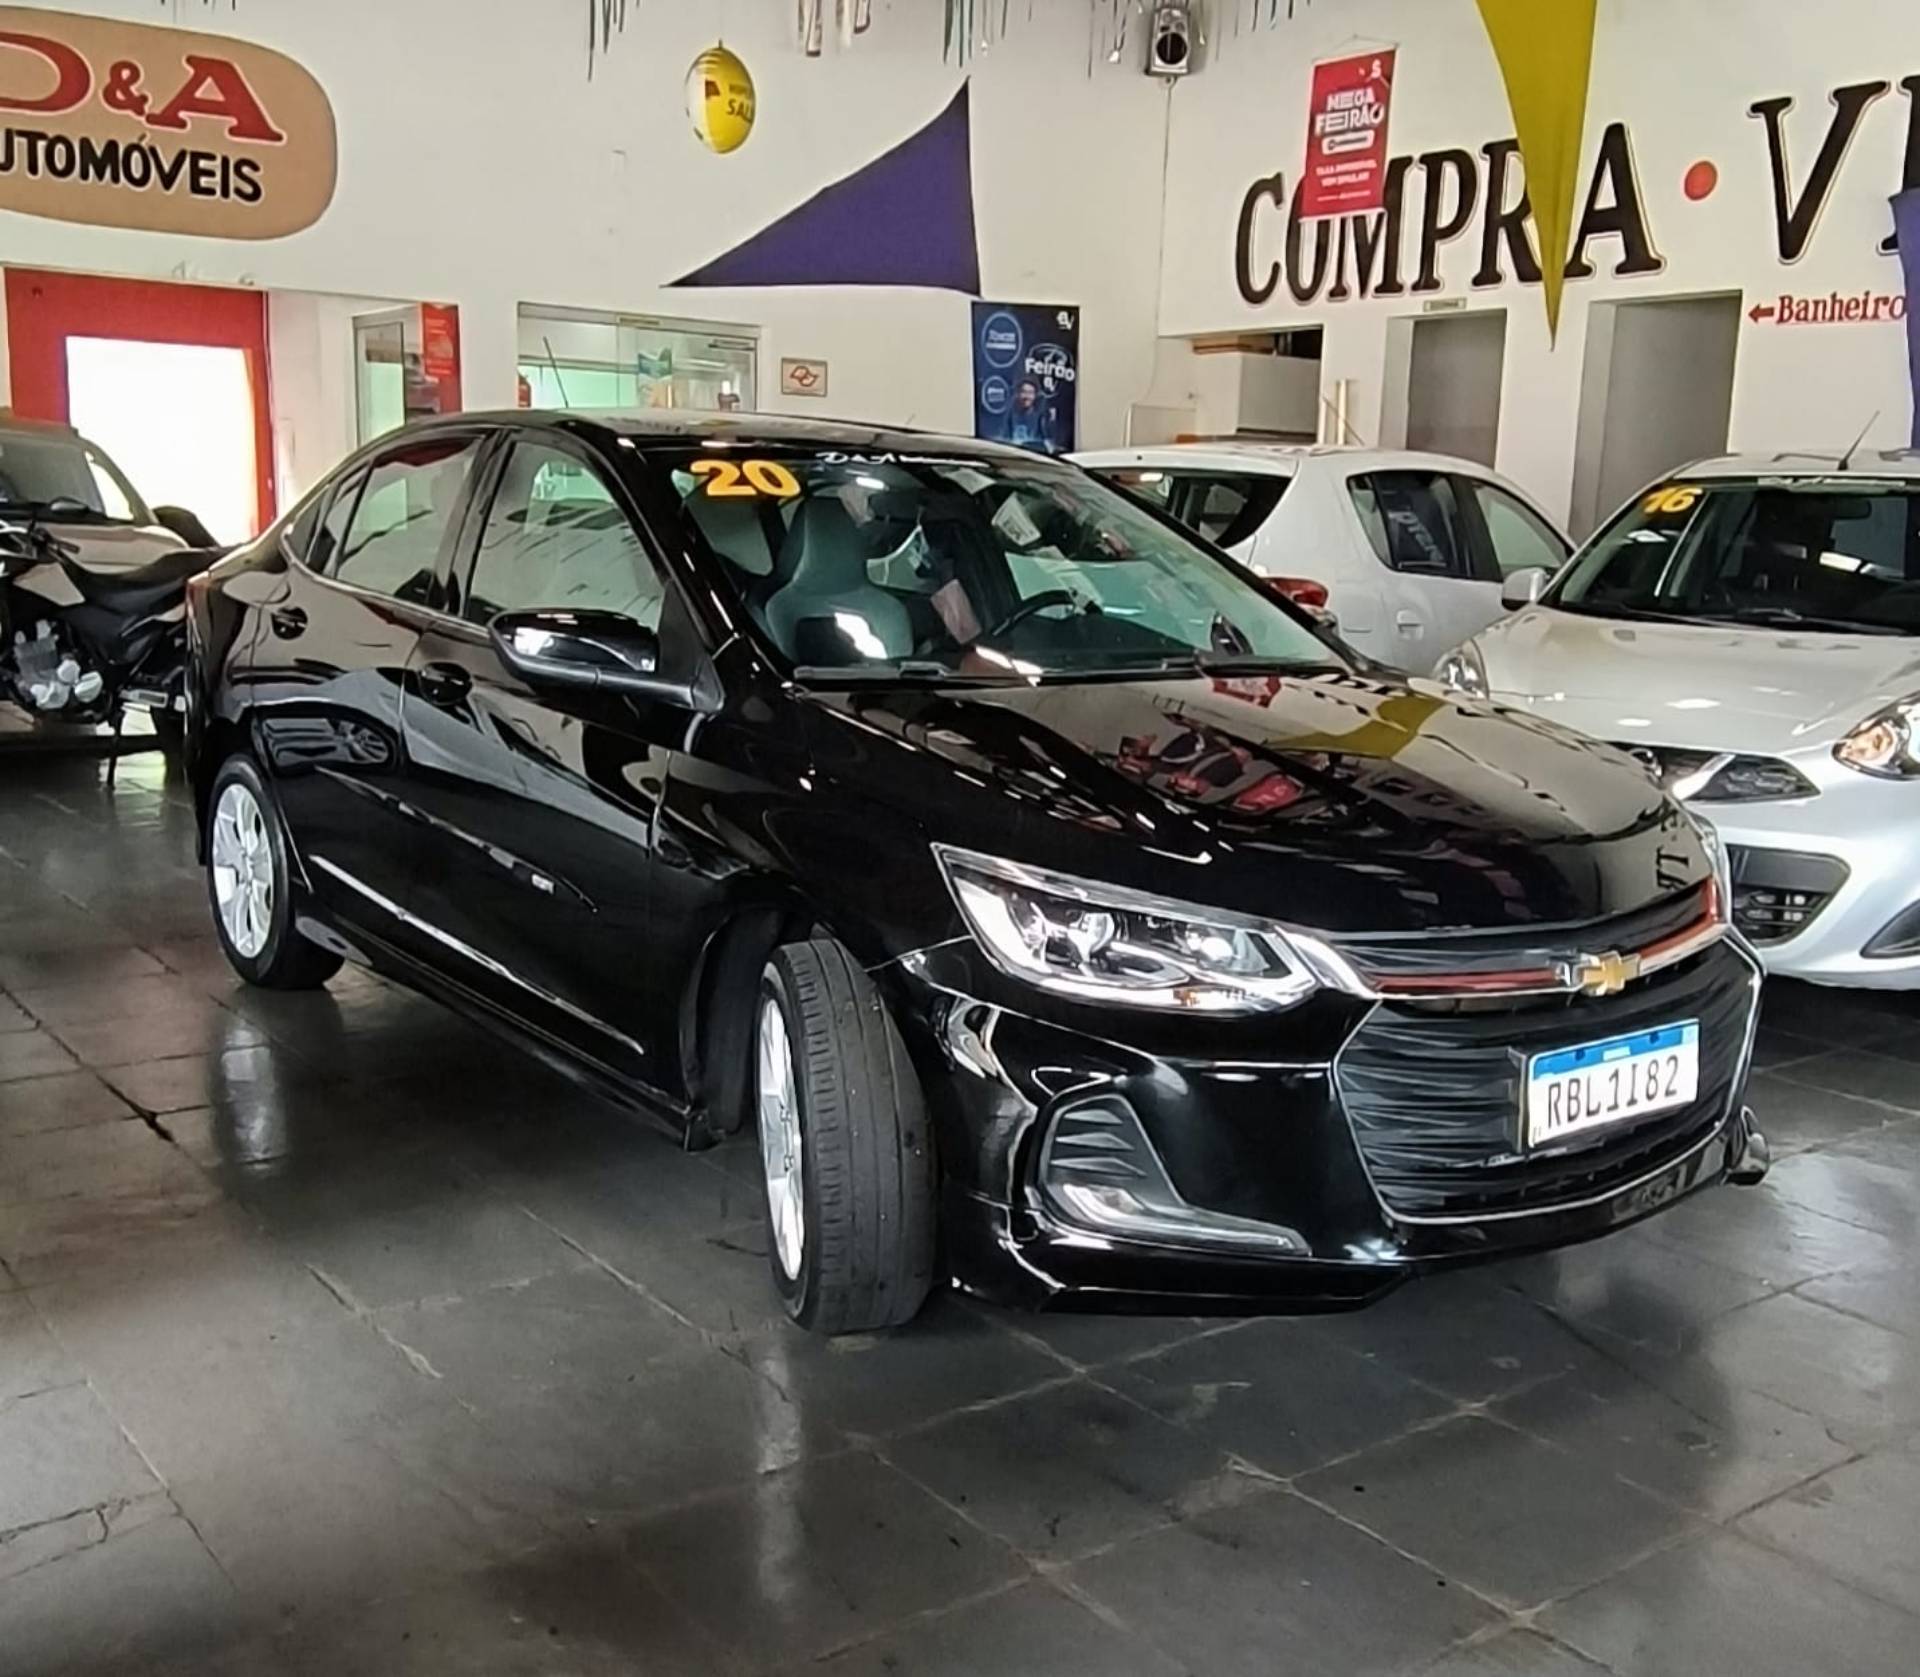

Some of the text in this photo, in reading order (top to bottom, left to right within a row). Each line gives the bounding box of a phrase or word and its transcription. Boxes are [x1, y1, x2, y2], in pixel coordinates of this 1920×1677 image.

[0, 31, 284, 142] D&A
[1235, 69, 1920, 305] COMPRA V
[1776, 290, 1906, 325] Banheiro
[1025, 358, 1075, 382] Feirão
[691, 459, 801, 497] 20
[1548, 1055, 1679, 1129] RBL1I82
